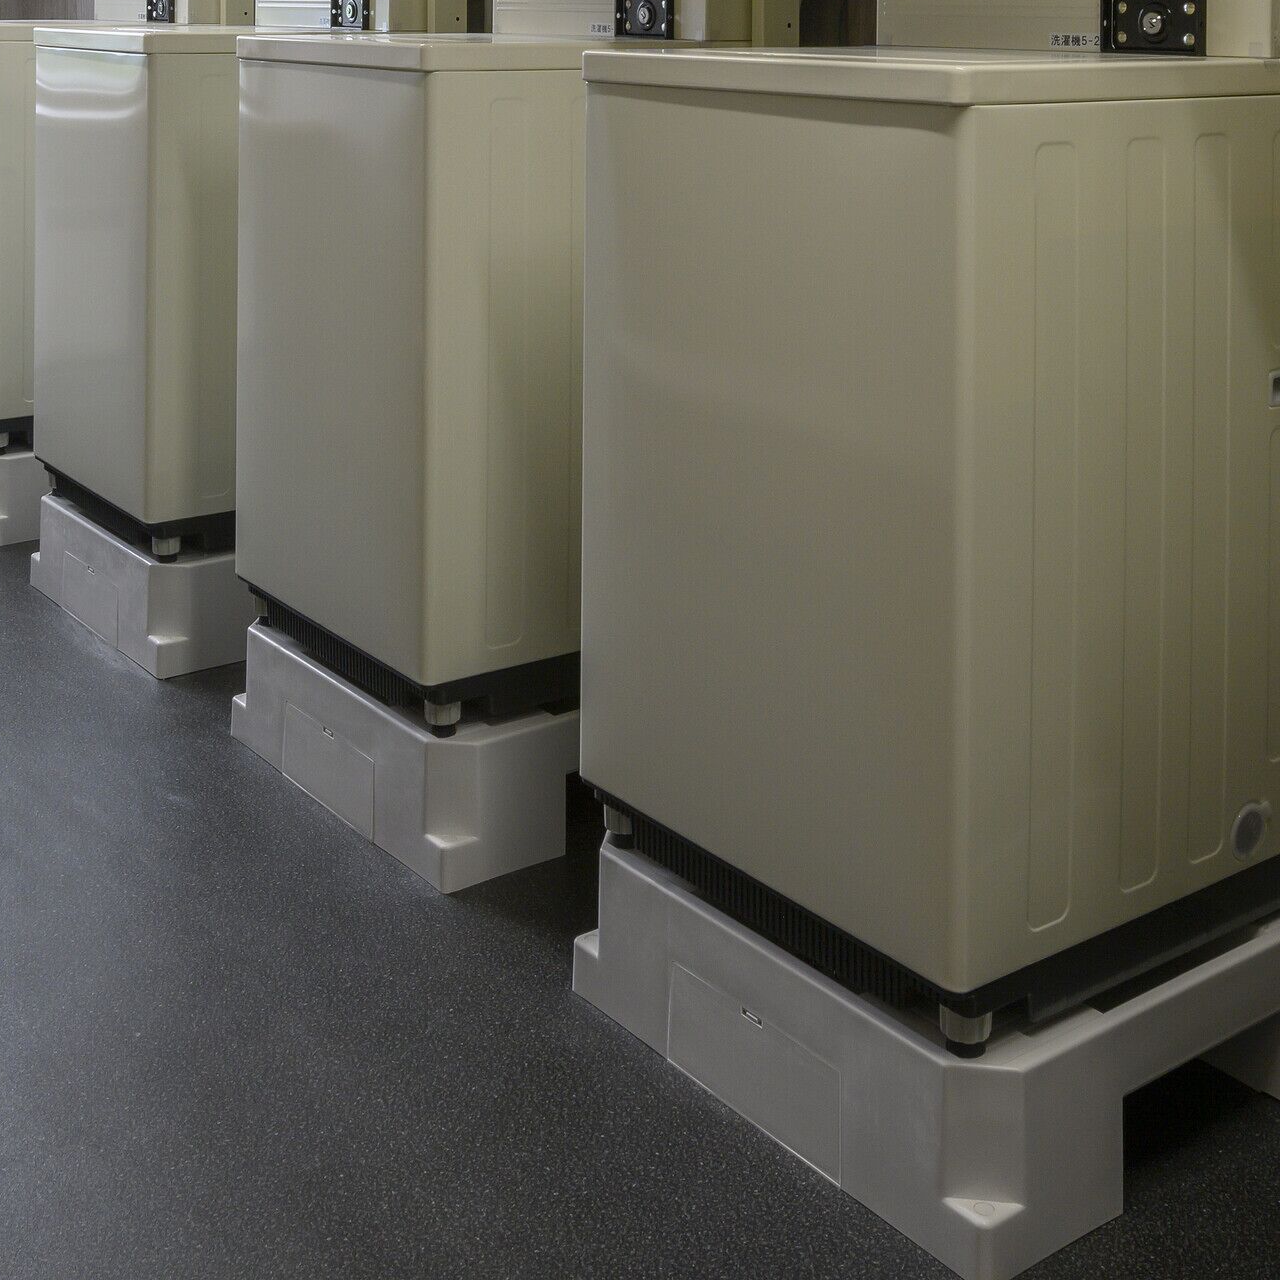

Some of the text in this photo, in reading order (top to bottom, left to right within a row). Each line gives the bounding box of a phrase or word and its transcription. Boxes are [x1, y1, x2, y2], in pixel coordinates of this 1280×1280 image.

[590, 24, 614, 33] 洗濯機5-
[1050, 34, 1100, 47] 洗濯機5-2
